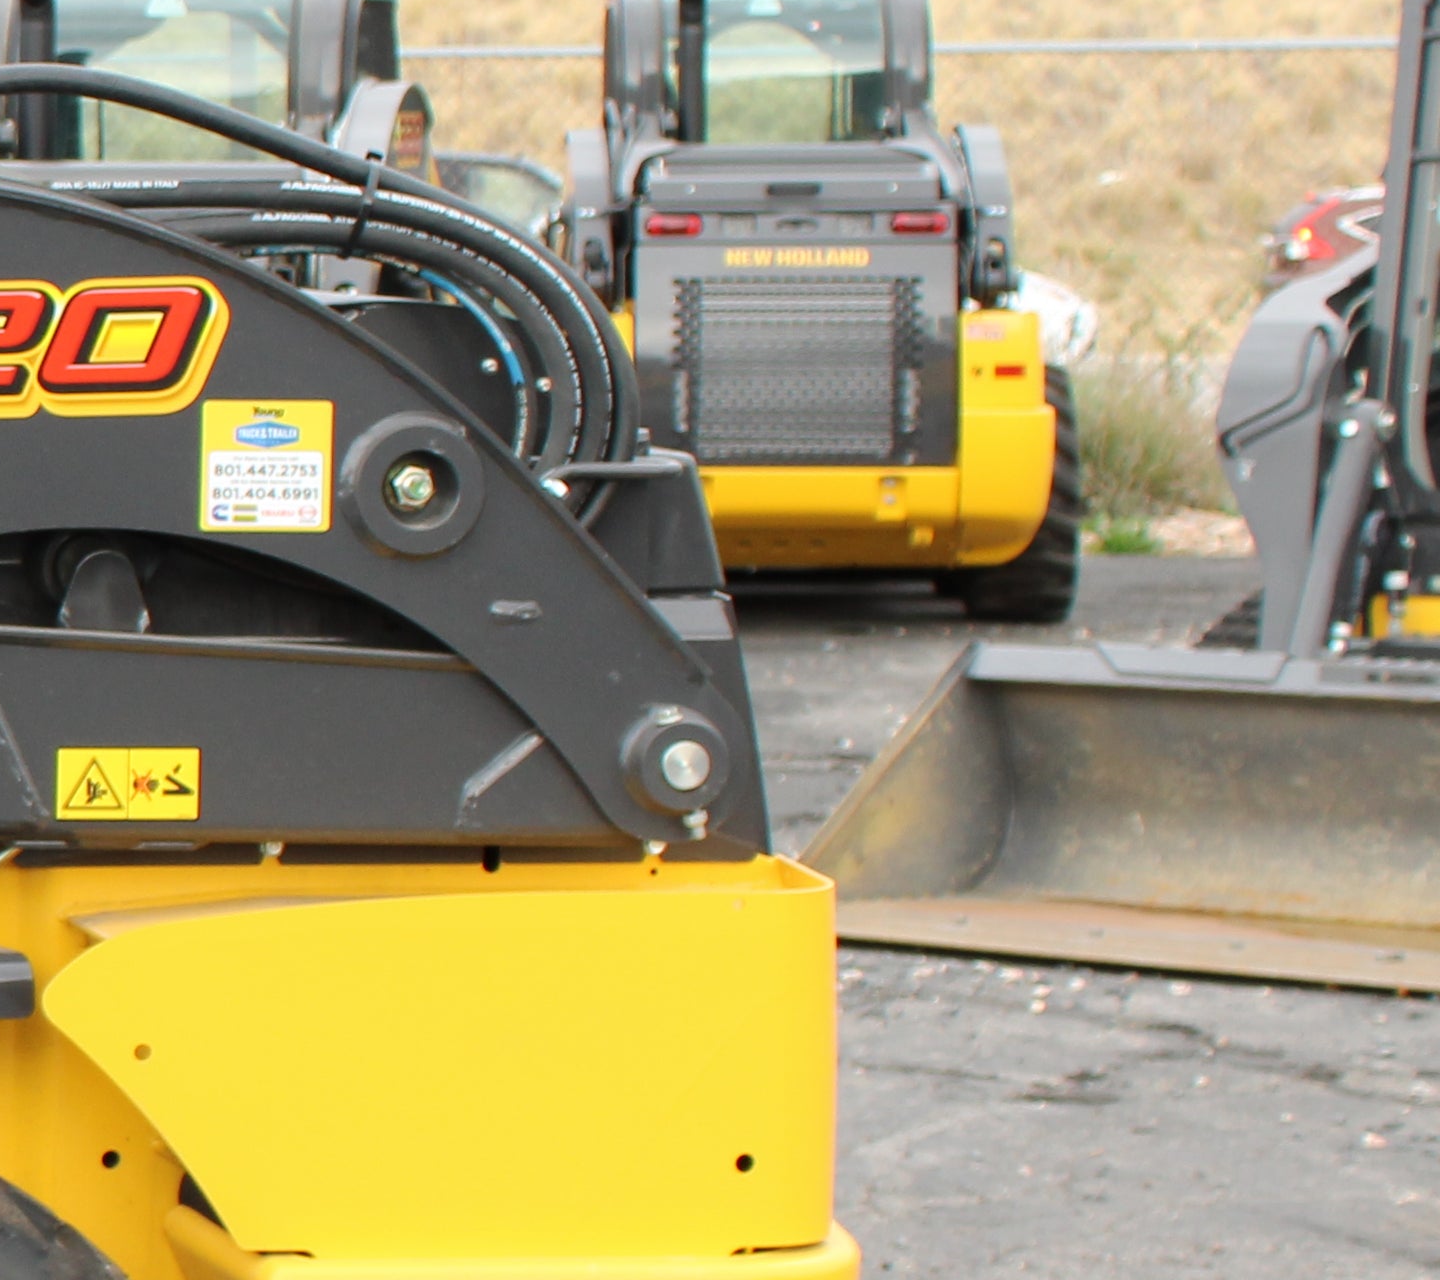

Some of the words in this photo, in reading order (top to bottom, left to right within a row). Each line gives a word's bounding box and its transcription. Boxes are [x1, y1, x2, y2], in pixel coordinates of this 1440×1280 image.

[726, 246, 774, 267] NEW
[776, 246, 871, 267] HOLLAND
[214, 464, 318, 477] 801.447.2753
[212, 487, 319, 500] 801.404.6991
